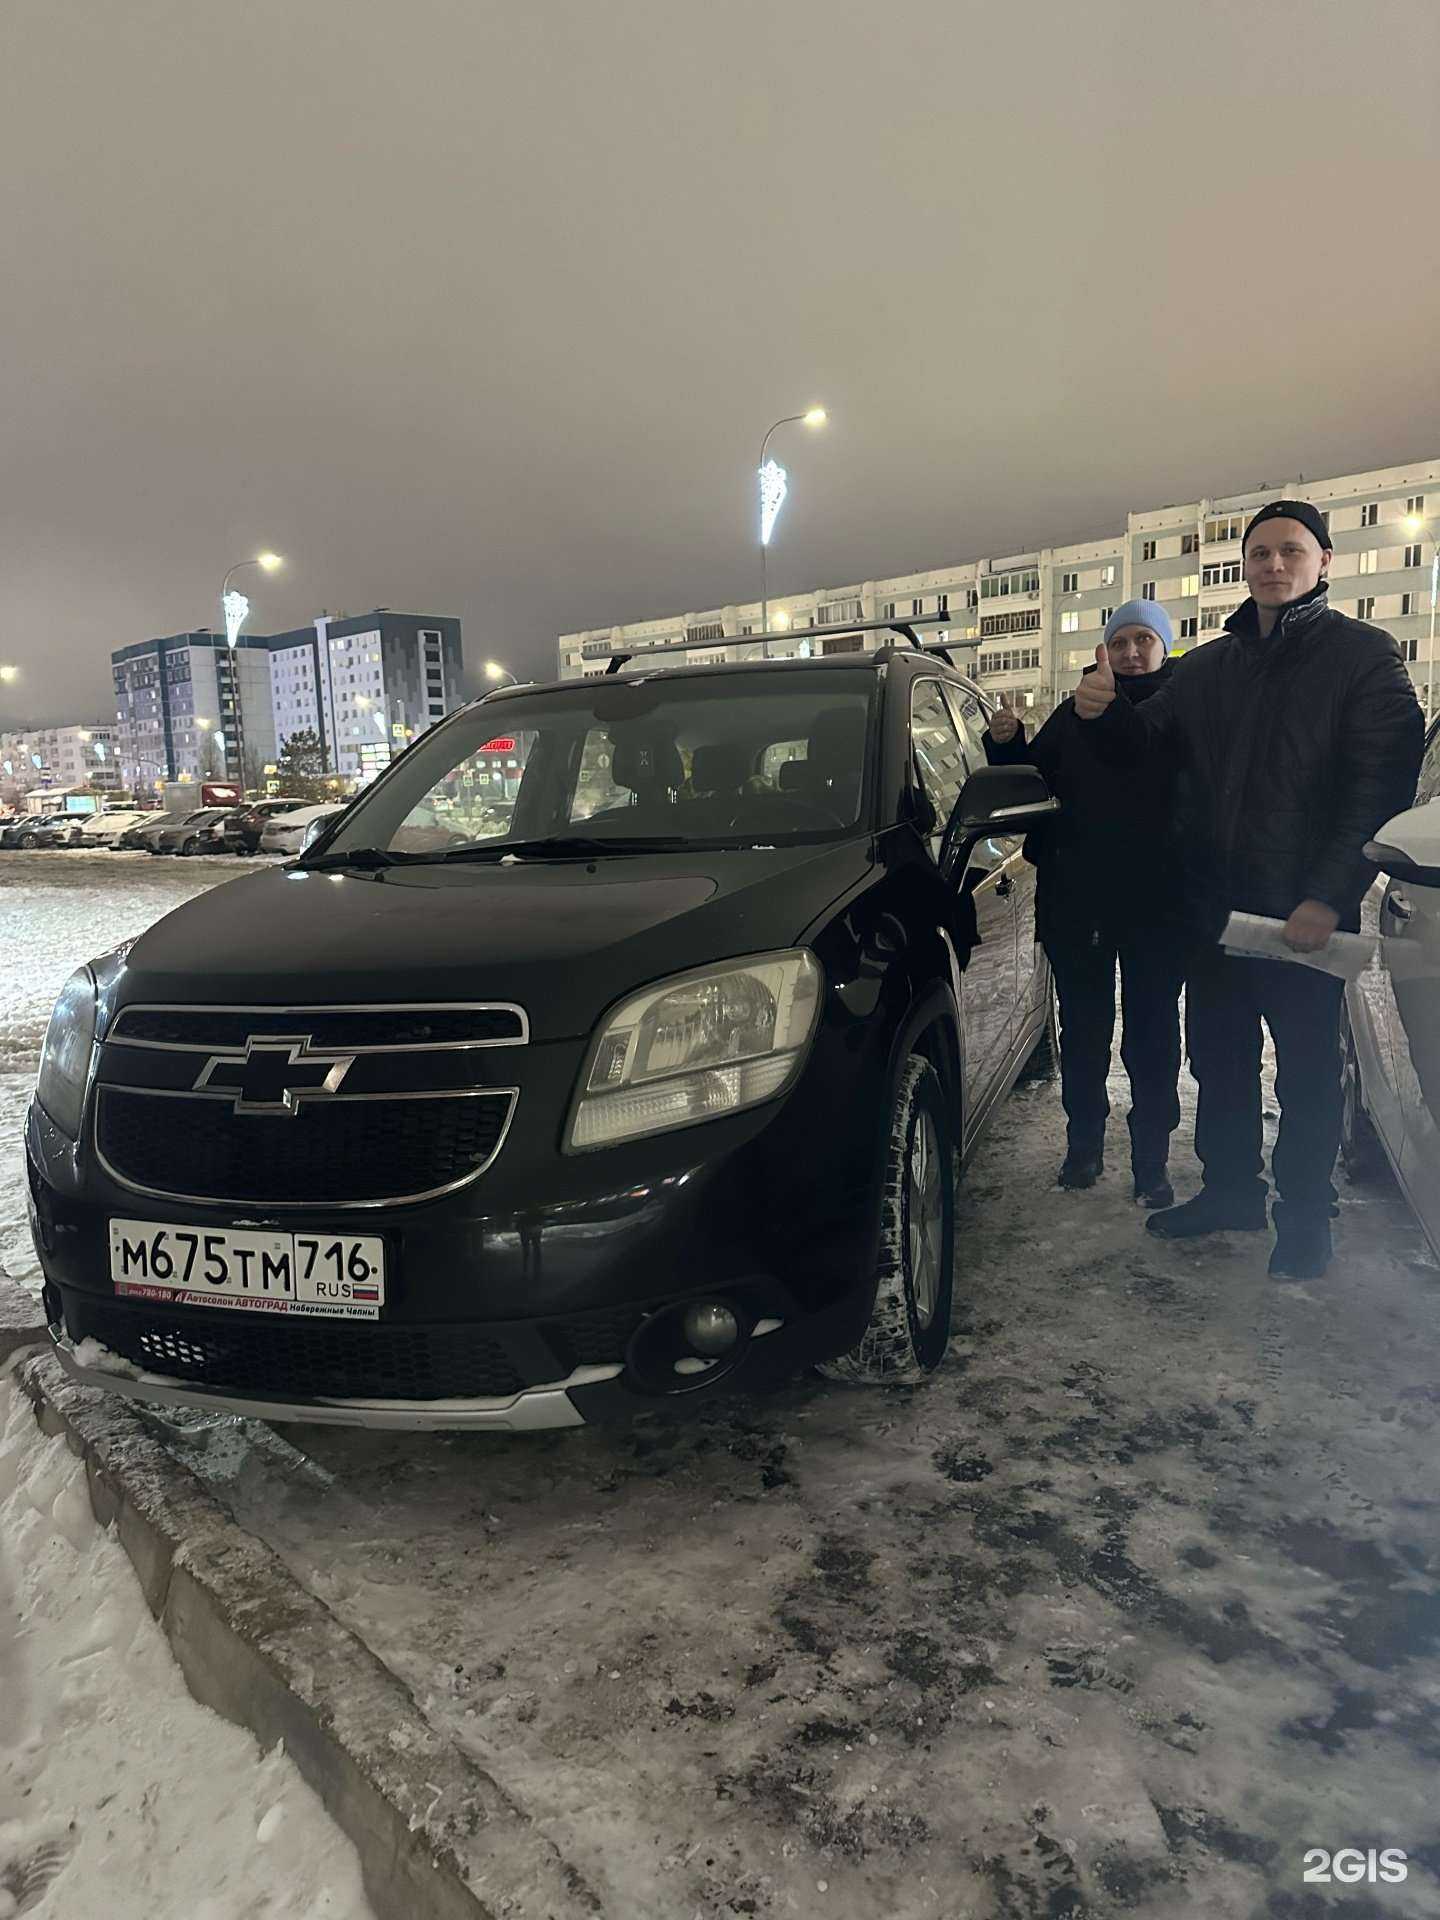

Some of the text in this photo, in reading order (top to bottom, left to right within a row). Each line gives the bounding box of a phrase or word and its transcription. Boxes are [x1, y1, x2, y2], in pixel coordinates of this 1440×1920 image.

[122, 1231, 371, 1292] М675ТМ 716
[316, 1282, 351, 1298] RUS
[235, 1299, 288, 1312] АВТОГРАД
[346, 1307, 375, 1317] Челны
